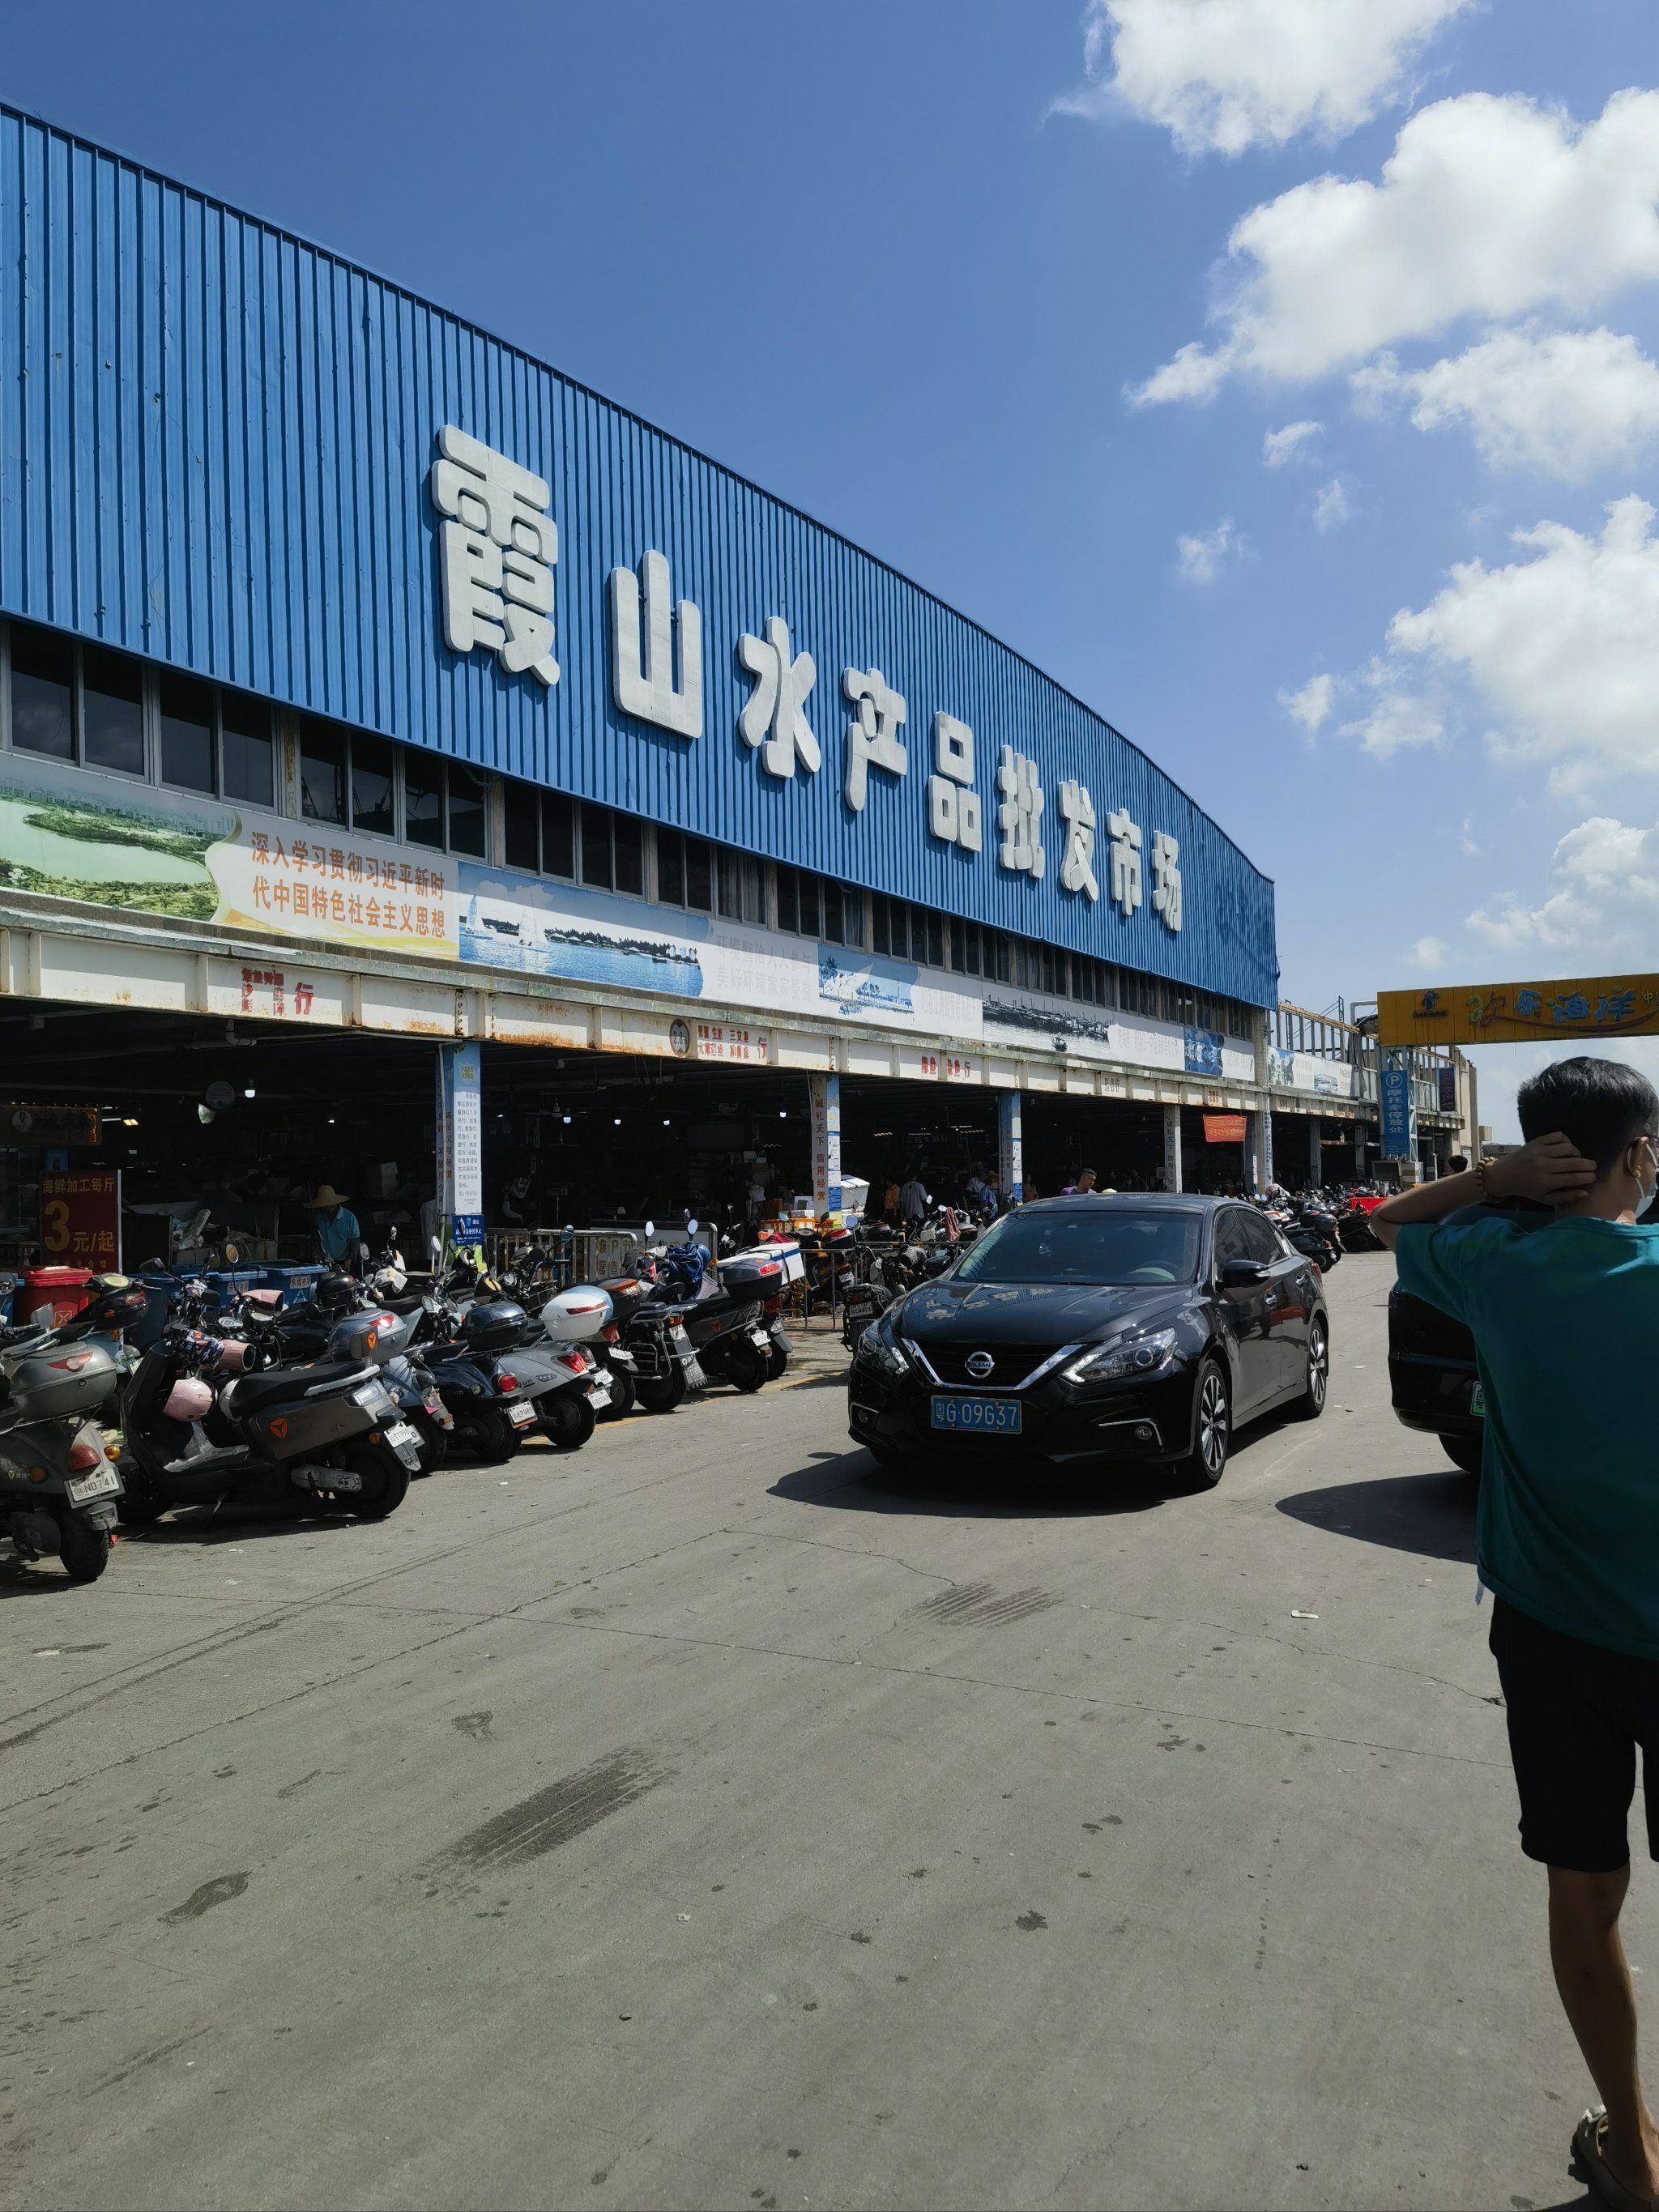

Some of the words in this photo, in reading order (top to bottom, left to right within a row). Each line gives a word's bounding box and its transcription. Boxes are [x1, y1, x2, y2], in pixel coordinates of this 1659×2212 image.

[432, 424, 1182, 933] 霞山水产品批发市场
[250, 831, 445, 901] 深入学习贯彻习近平新时
[253, 876, 445, 939] 代中国特色社会主义思想
[1387, 1089, 1405, 1133] 摩托车停放处
[43, 1177, 115, 1194] 海鲜加工每斤
[966, 1361, 993, 1369] NISSAN
